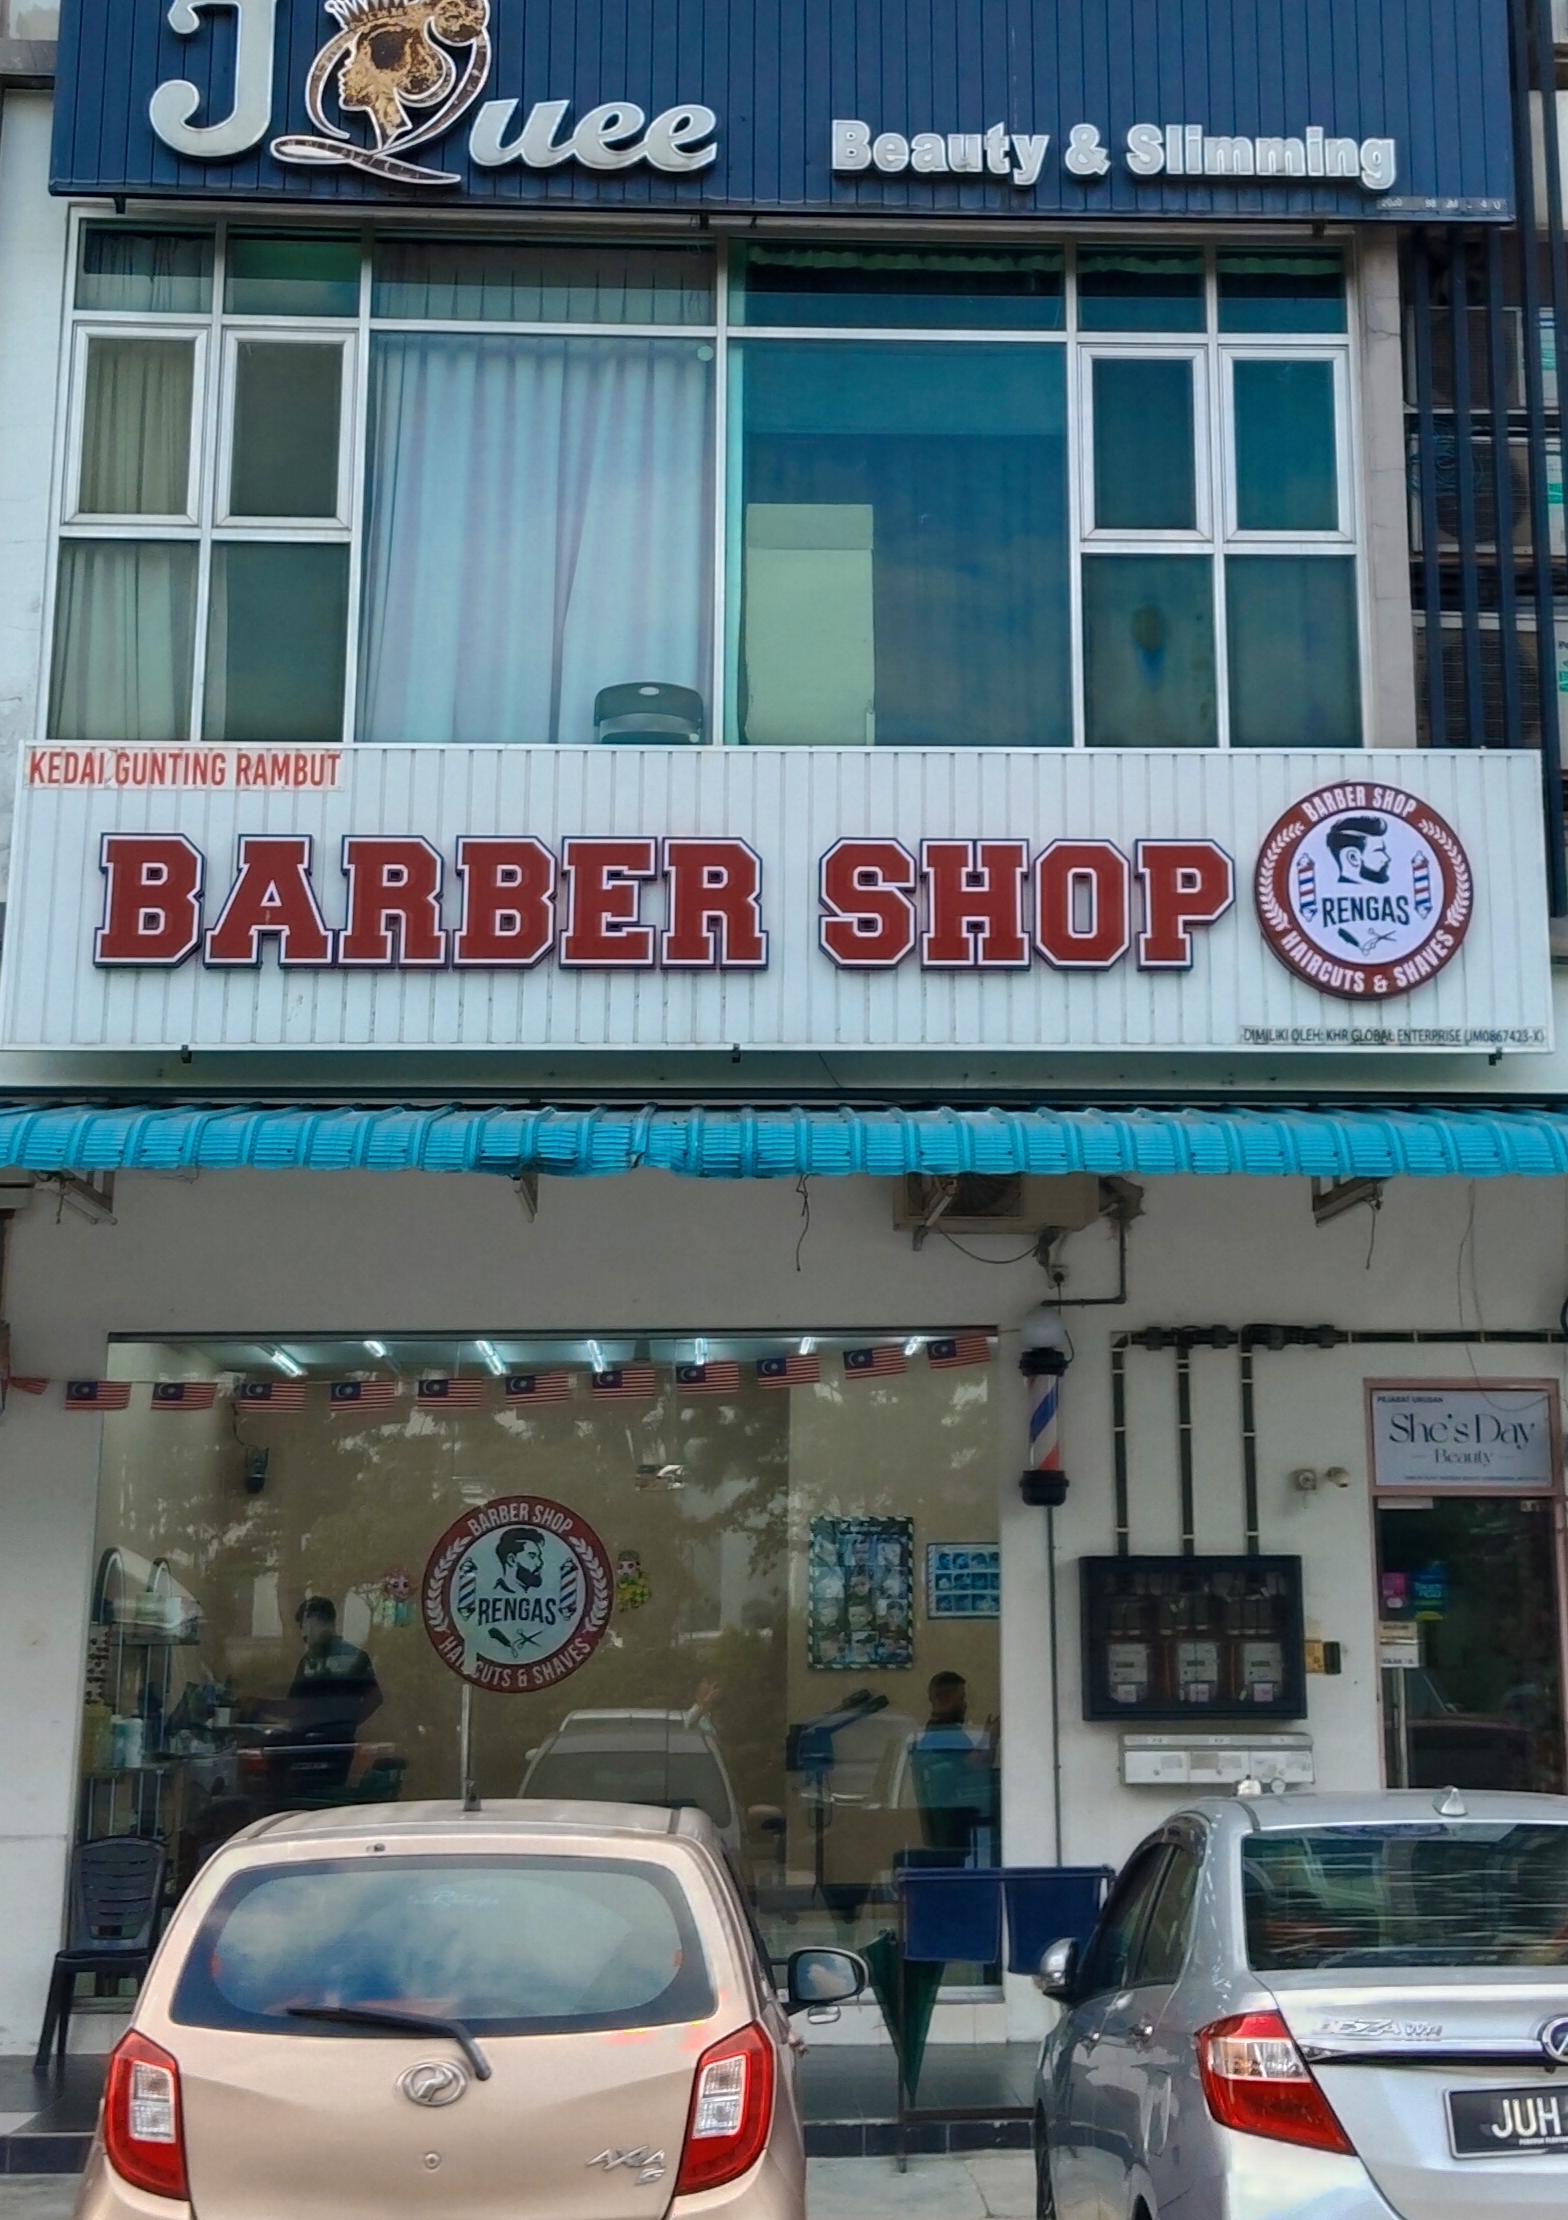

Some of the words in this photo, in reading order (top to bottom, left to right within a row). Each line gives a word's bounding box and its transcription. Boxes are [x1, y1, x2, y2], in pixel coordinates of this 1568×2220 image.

[832, 119, 1049, 186] Beauty
[1065, 123, 1110, 176] &
[1126, 123, 1396, 190] Slimming
[29, 752, 105, 784] KEDAI
[115, 752, 226, 785] GUNTING
[236, 753, 341, 786] RAMBUT
[1302, 786, 1366, 822] BARBER
[1372, 786, 1417, 817] SHOP
[94, 833, 768, 969] BARBER
[819, 837, 1235, 971] SHOP
[1322, 895, 1410, 927] RENGAS
[1281, 931, 1365, 993] HAIRCUTS
[1373, 974, 1388, 993] &
[1394, 929, 1454, 987] SHAVES
[1244, 1028, 1288, 1042] DIMILIKI
[1326, 1028, 1349, 1042] KHR
[1351, 1028, 1394, 1042] GLOBAL
[1398, 1029, 1461, 1042] ENTERPRISE
[1389, 1413, 1469, 1443] She's
[1476, 1413, 1535, 1449] Day
[1435, 1449, 1493, 1467] Beauty
[468, 1503, 529, 1535] BARBER
[532, 1504, 573, 1533] SHOP
[478, 1598, 557, 1626] RENGAS
[439, 1636, 512, 1687] HAICUTS
[518, 1669, 528, 1687] &
[533, 1637, 592, 1684] SHAVES
[1491, 2096, 1562, 2138] JUH
